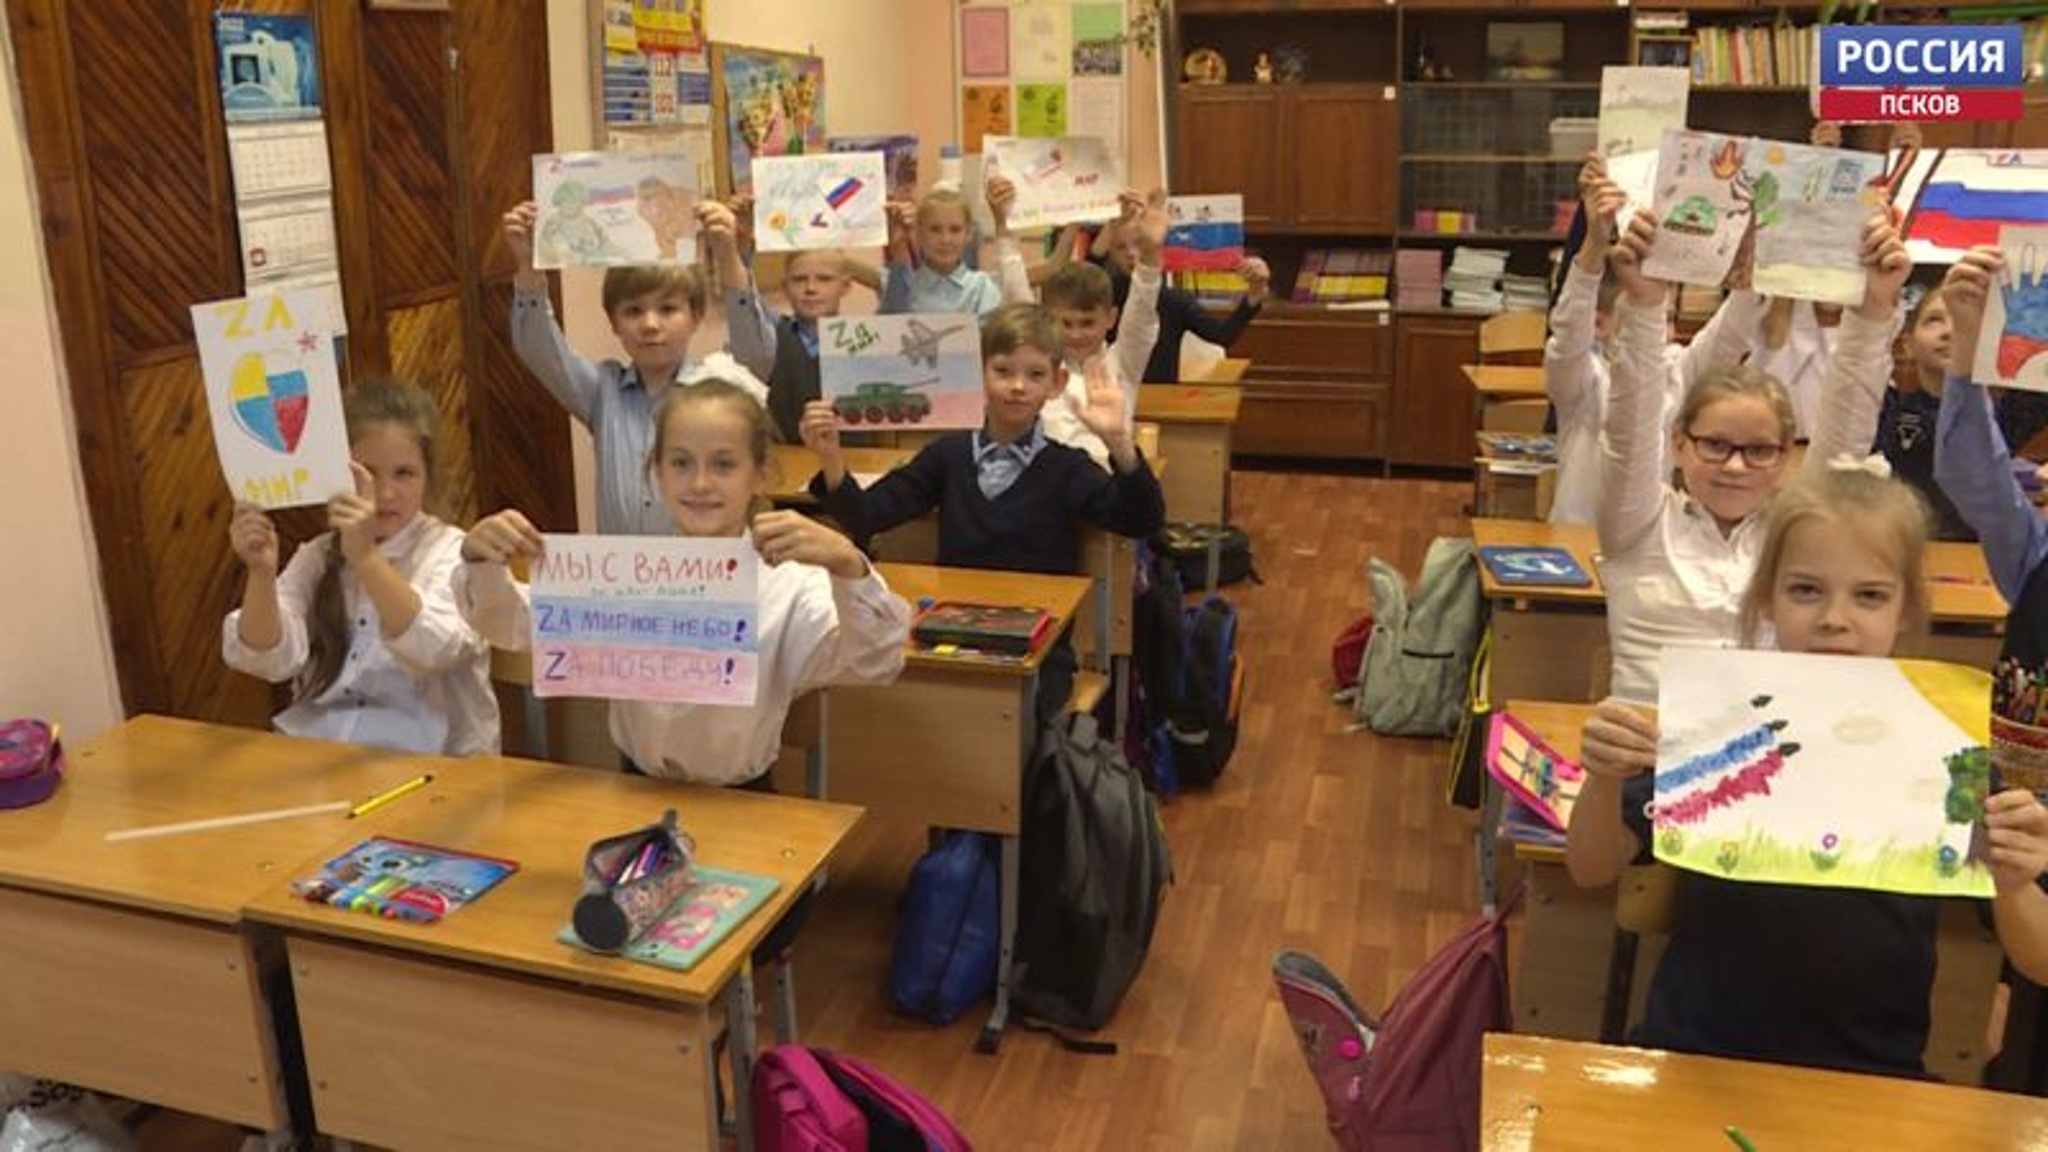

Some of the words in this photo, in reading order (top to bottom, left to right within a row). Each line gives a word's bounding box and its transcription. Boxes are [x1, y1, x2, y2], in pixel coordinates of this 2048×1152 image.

[536, 552, 592, 582] МЫ
[601, 553, 618, 582] С
[634, 553, 738, 584] ВАМИ!
[581, 610, 662, 635] МИРНОЕ
[671, 618, 747, 643] НЕБО!
